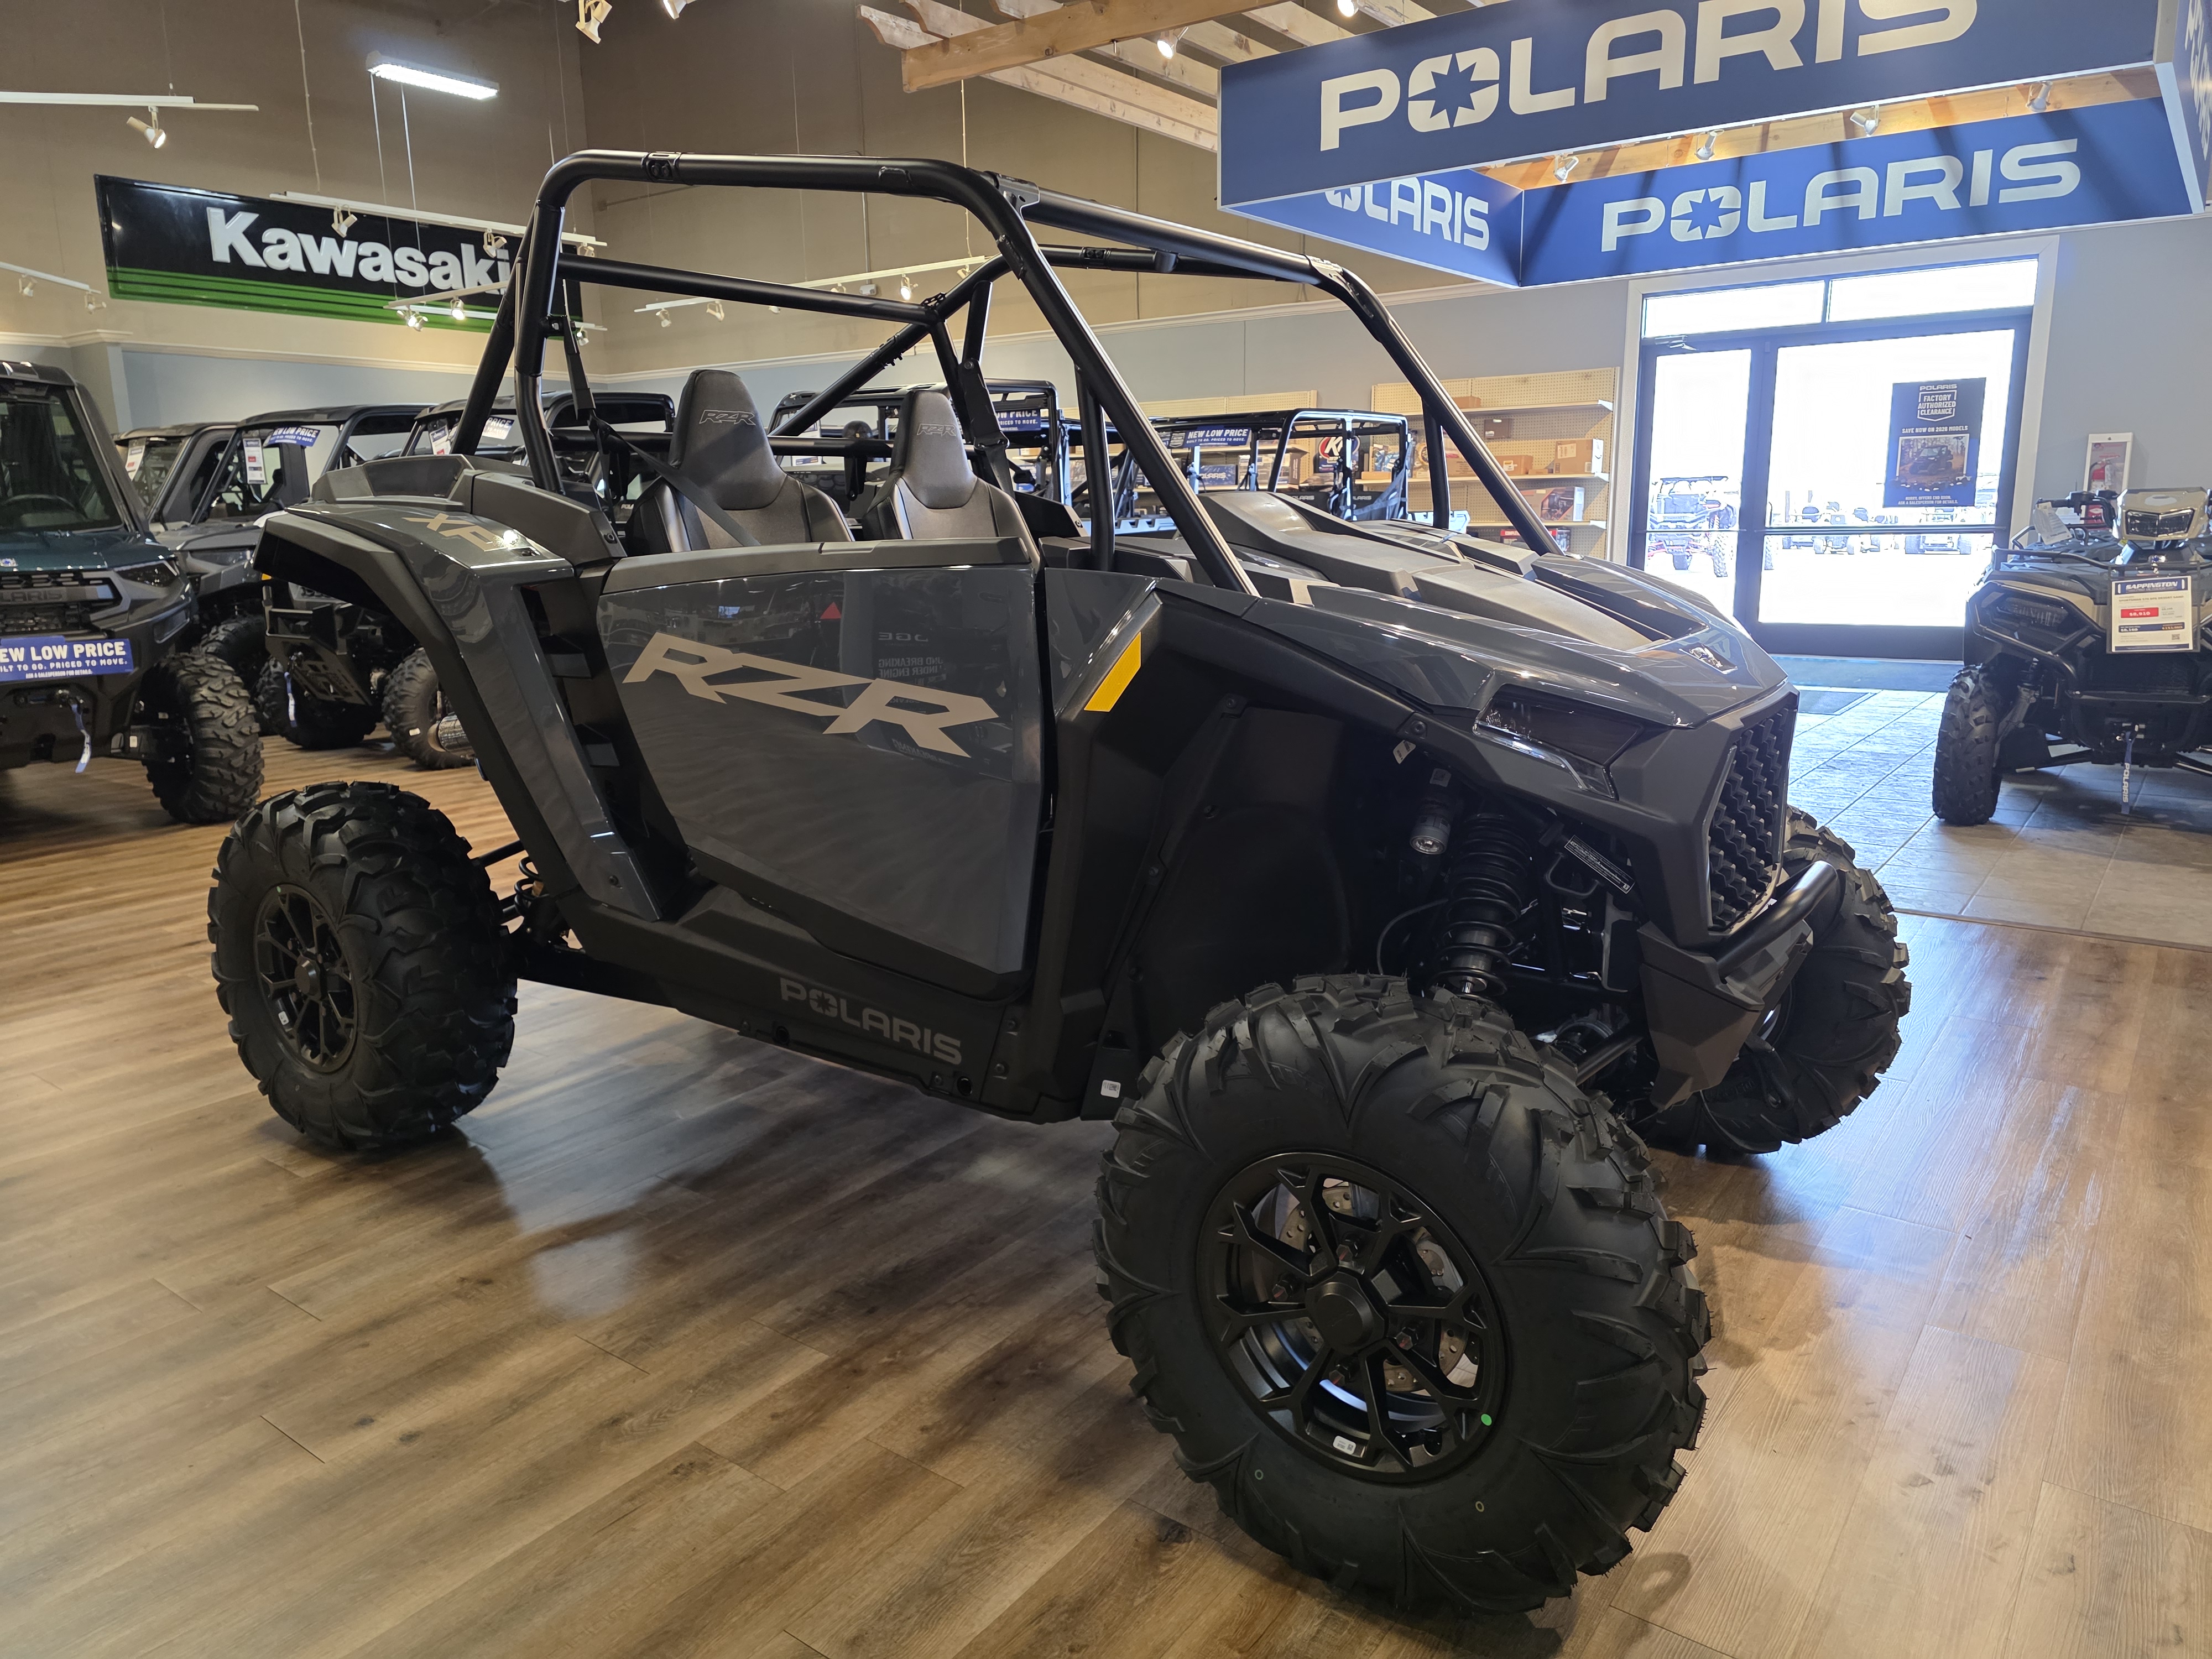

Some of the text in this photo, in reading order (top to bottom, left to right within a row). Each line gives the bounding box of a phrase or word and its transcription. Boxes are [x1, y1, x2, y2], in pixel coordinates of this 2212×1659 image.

[1320, 0, 1977, 152] POLARIS
[1601, 138, 2080, 252] POLARIS
[207, 207, 510, 295] Kawasaki
[1918, 401, 1956, 409] AUTHORIZED
[699, 410, 756, 425] RZR
[295, 427, 319, 437] PRICE
[917, 423, 957, 436] RZR
[1188, 431, 1205, 439] NEW
[402, 513, 509, 551] XP
[2126, 581, 2178, 590] SAPPINGTON
[0, 641, 126, 662] EW LOW PRICE
[50, 661, 82, 670] PRICED
[622, 631, 999, 758] RZR
[780, 977, 962, 1065] POLARIS
